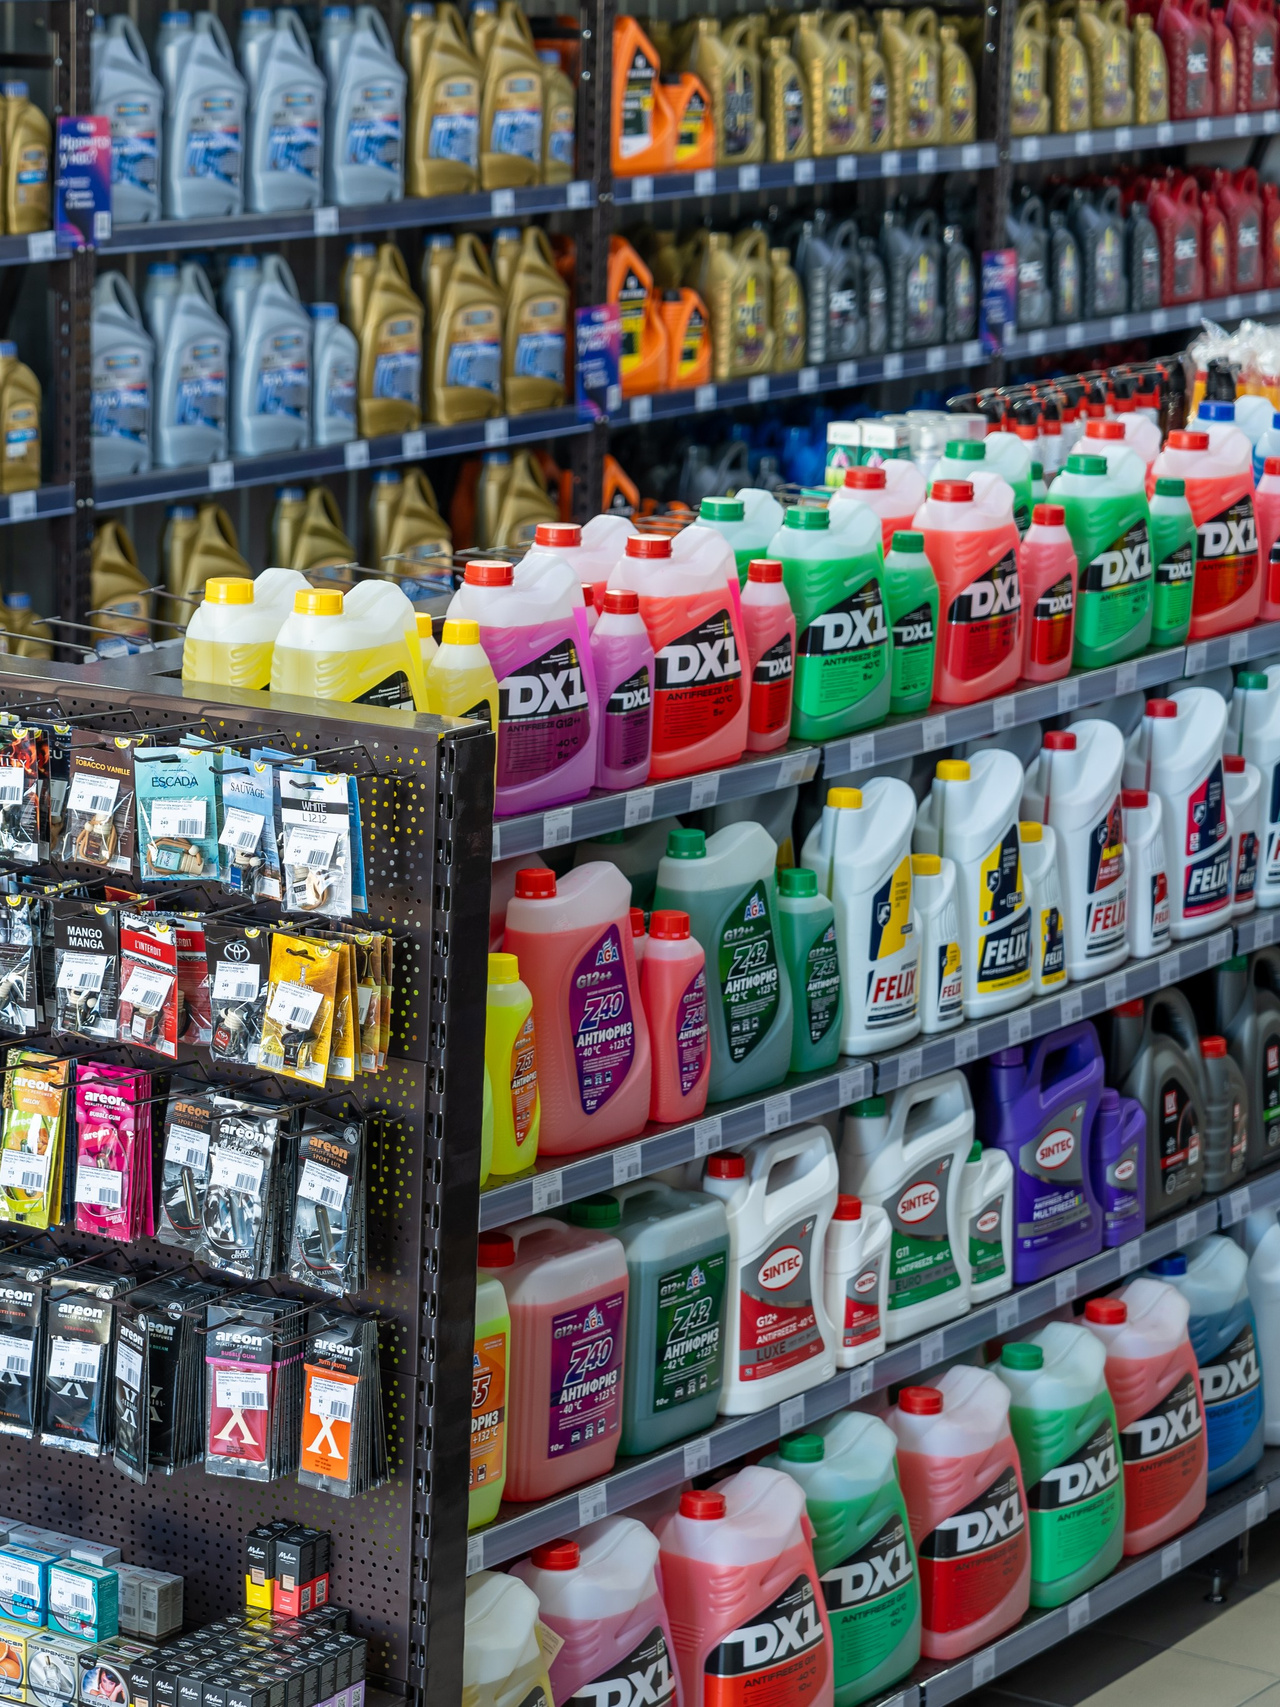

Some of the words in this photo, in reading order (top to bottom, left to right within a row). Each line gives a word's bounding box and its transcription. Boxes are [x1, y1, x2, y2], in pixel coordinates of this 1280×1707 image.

[1197, 516, 1259, 558] DX1
[1092, 540, 1151, 588] DX1
[961, 573, 1021, 620] DX1
[1038, 593, 1073, 615] DX1
[809, 608, 888, 653] DX1
[893, 619, 934, 644] DX1
[656, 635, 742, 684] DX1
[758, 655, 792, 677] DX1
[822, 654, 870, 668] ANTIFREEZE
[499, 667, 588, 717] DX1
[610, 687, 651, 710] DX1
[667, 687, 721, 702] ANTIFREEZE
[507, 720, 555, 732] ANTIFREEZE
[556, 717, 581, 729] G12++
[75, 758, 106, 771] TOBACCO
[107, 764, 131, 776] VANILLE
[151, 776, 199, 788] ESCADA
[230, 783, 265, 799] SAUVAGE
[301, 800, 327, 813] WHITE
[1189, 861, 1228, 895] FELIX
[744, 901, 766, 922] AGA
[1091, 900, 1125, 933] FELIX
[1154, 910, 1169, 924] FELIX
[67, 926, 103, 938] MANGO
[69, 936, 105, 949] MANGA
[724, 926, 754, 941] G12++
[134, 940, 161, 957] L'INTERDIT
[596, 947, 619, 966] AGA
[983, 932, 1028, 968] FELIX
[1043, 946, 1063, 967] FELIX
[727, 940, 769, 980] Z42
[576, 971, 612, 988] G12++
[724, 968, 777, 995] АНТИФРИЗ
[807, 975, 839, 991] АНТИФРИЗ
[873, 968, 915, 1003] FELIX
[942, 982, 962, 998] FELIX
[578, 991, 625, 1032] Z40
[576, 1021, 632, 1048] АНТИФРИЗ
[678, 1023, 708, 1042] АНТИФРИЗ
[578, 1045, 592, 1058] -40
[609, 1039, 625, 1052] +123
[12, 1076, 54, 1091] areon
[84, 1091, 125, 1105] areon
[89, 1111, 108, 1120] BUBBLE
[174, 1101, 210, 1118] areon
[177, 1118, 194, 1127] SPORT
[220, 1123, 265, 1143] areon
[309, 1136, 349, 1159] areon
[1038, 1138, 1072, 1160] SINTEC
[312, 1153, 329, 1164] SPORT
[330, 1158, 341, 1169] LUX
[900, 1191, 937, 1215] SINTEC
[1033, 1199, 1076, 1221] MULTIFREEZE
[979, 1212, 999, 1227] SINTEC
[895, 1246, 910, 1259] G11
[762, 1254, 801, 1283] SINTEC
[895, 1255, 933, 1275] ANTIFREEZE
[854, 1274, 877, 1291] SINTEC
[895, 1275, 921, 1291] EURO
[58, 1302, 105, 1318] areon
[666, 1296, 713, 1345] Z42
[756, 1312, 778, 1328] G12+
[554, 1323, 583, 1339] G12++
[583, 1312, 604, 1333] AGA
[120, 1324, 144, 1346] areon
[215, 1331, 263, 1347] areon
[663, 1328, 719, 1361] АНТИФРИЗ
[756, 1323, 797, 1345] ANTIFREEZE
[221, 1350, 241, 1358] BUBBLE
[314, 1338, 354, 1357] areon
[756, 1341, 787, 1362] LUXE
[562, 1336, 614, 1388] Z40
[559, 1370, 617, 1404] АНТИФРИЗ
[1200, 1355, 1260, 1400] DX1
[1122, 1403, 1202, 1456] DX1
[1038, 1445, 1119, 1504] DX1
[1056, 1499, 1103, 1522] ANTIFREEZE
[934, 1498, 1025, 1554] DX1
[820, 1546, 913, 1604] DX1
[841, 1599, 895, 1624] ANTIFREEZE
[721, 1602, 824, 1667] DX1
[40, 1647, 76, 1662] SPENCER
[743, 1660, 803, 1688] ANTIFREEZE
[804, 1654, 816, 1665] G11
